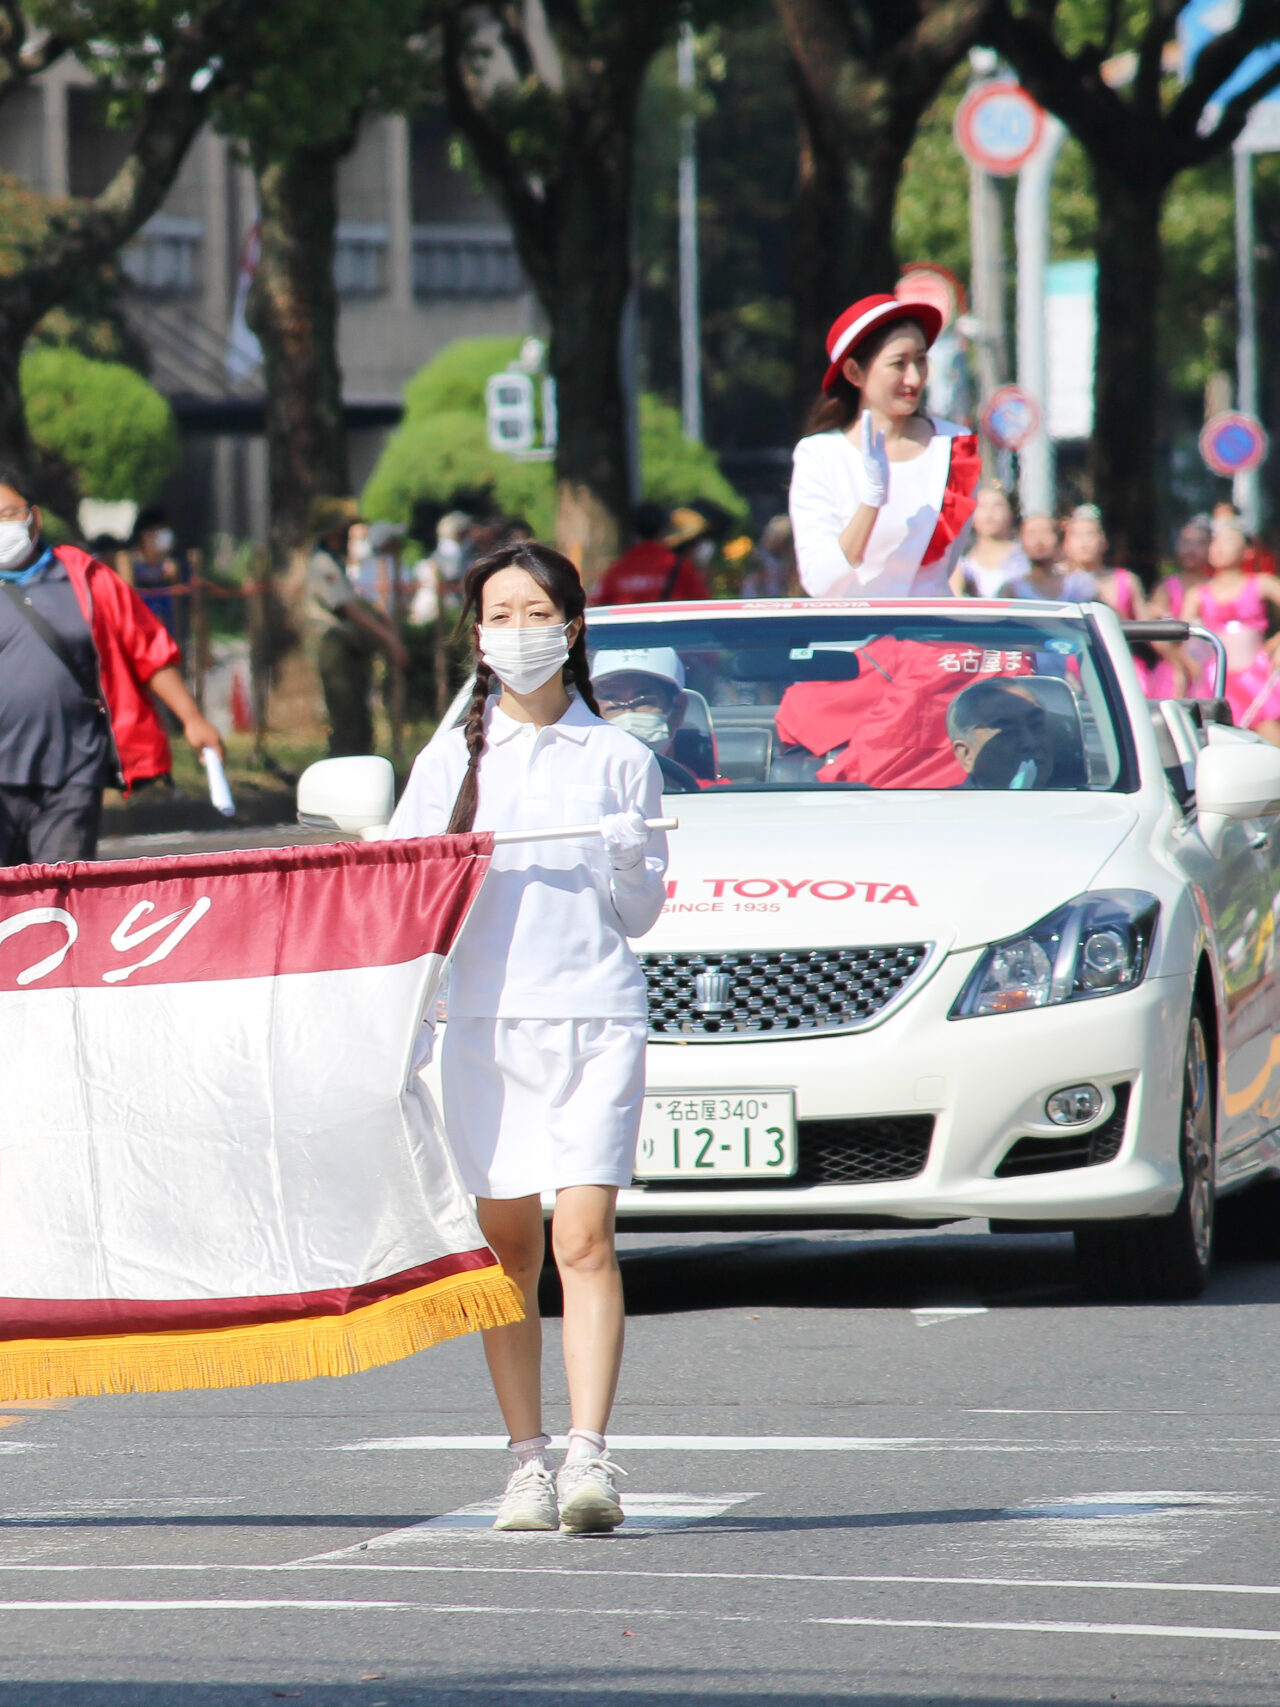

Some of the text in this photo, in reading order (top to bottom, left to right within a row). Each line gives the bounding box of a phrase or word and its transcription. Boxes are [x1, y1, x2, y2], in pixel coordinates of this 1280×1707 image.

[801, 600, 871, 609] TOYOTA
[702, 878, 920, 907] TOYOTA
[660, 902, 781, 914] SINCE 1935
[673, 1126, 785, 1169] 12-13
